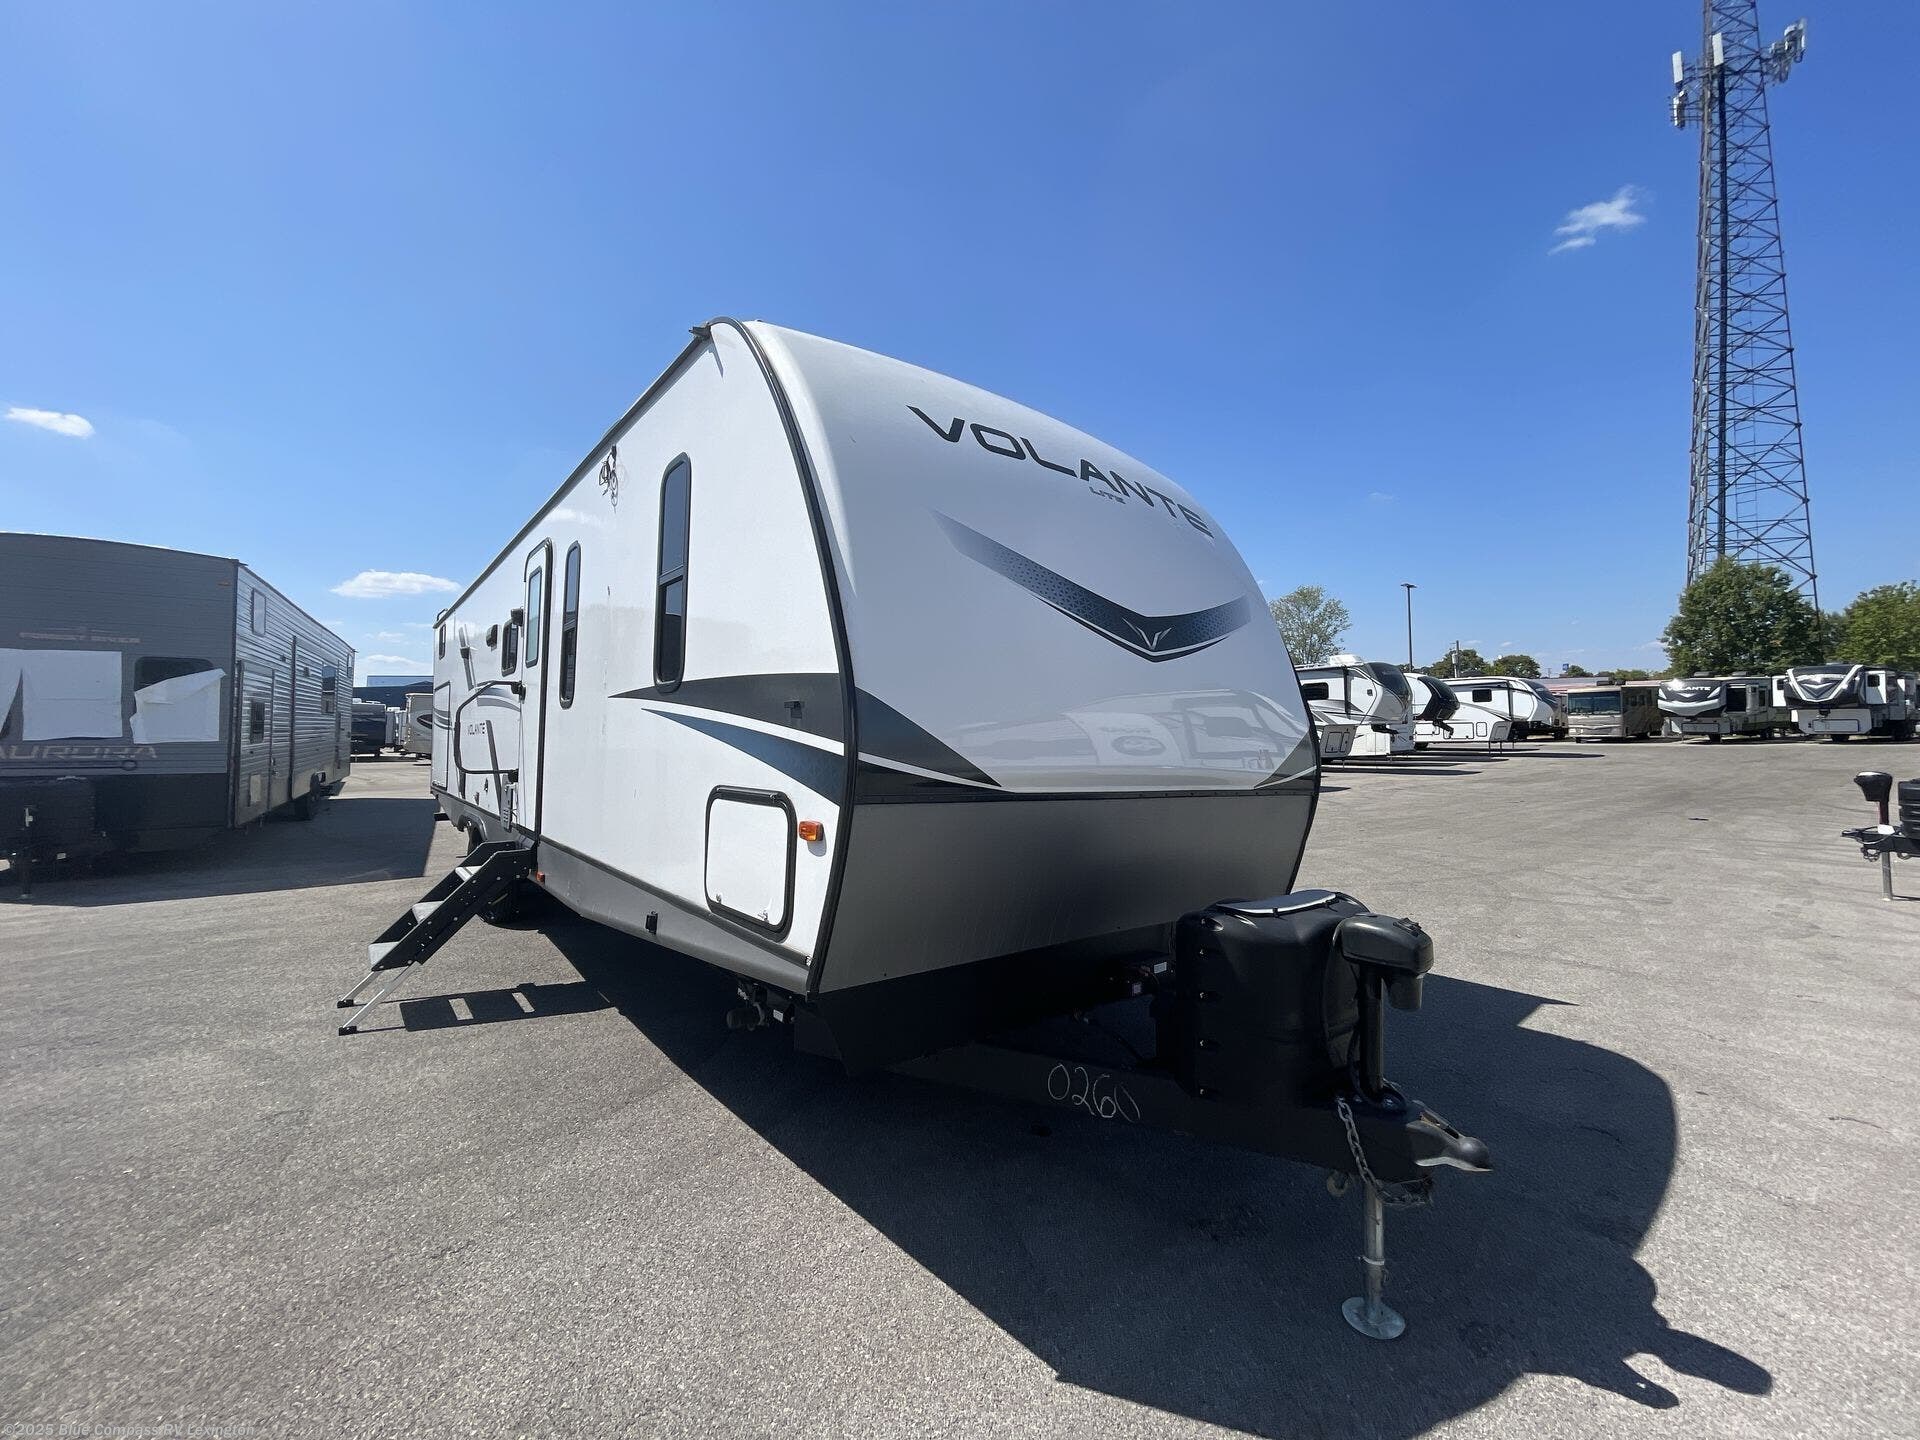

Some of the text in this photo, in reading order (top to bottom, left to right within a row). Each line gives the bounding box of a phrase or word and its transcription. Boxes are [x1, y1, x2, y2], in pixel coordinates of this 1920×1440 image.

[905, 404, 1215, 539] VOLANTE
[1089, 486, 1126, 504] LITE
[1047, 1062, 1141, 1123] 0260
